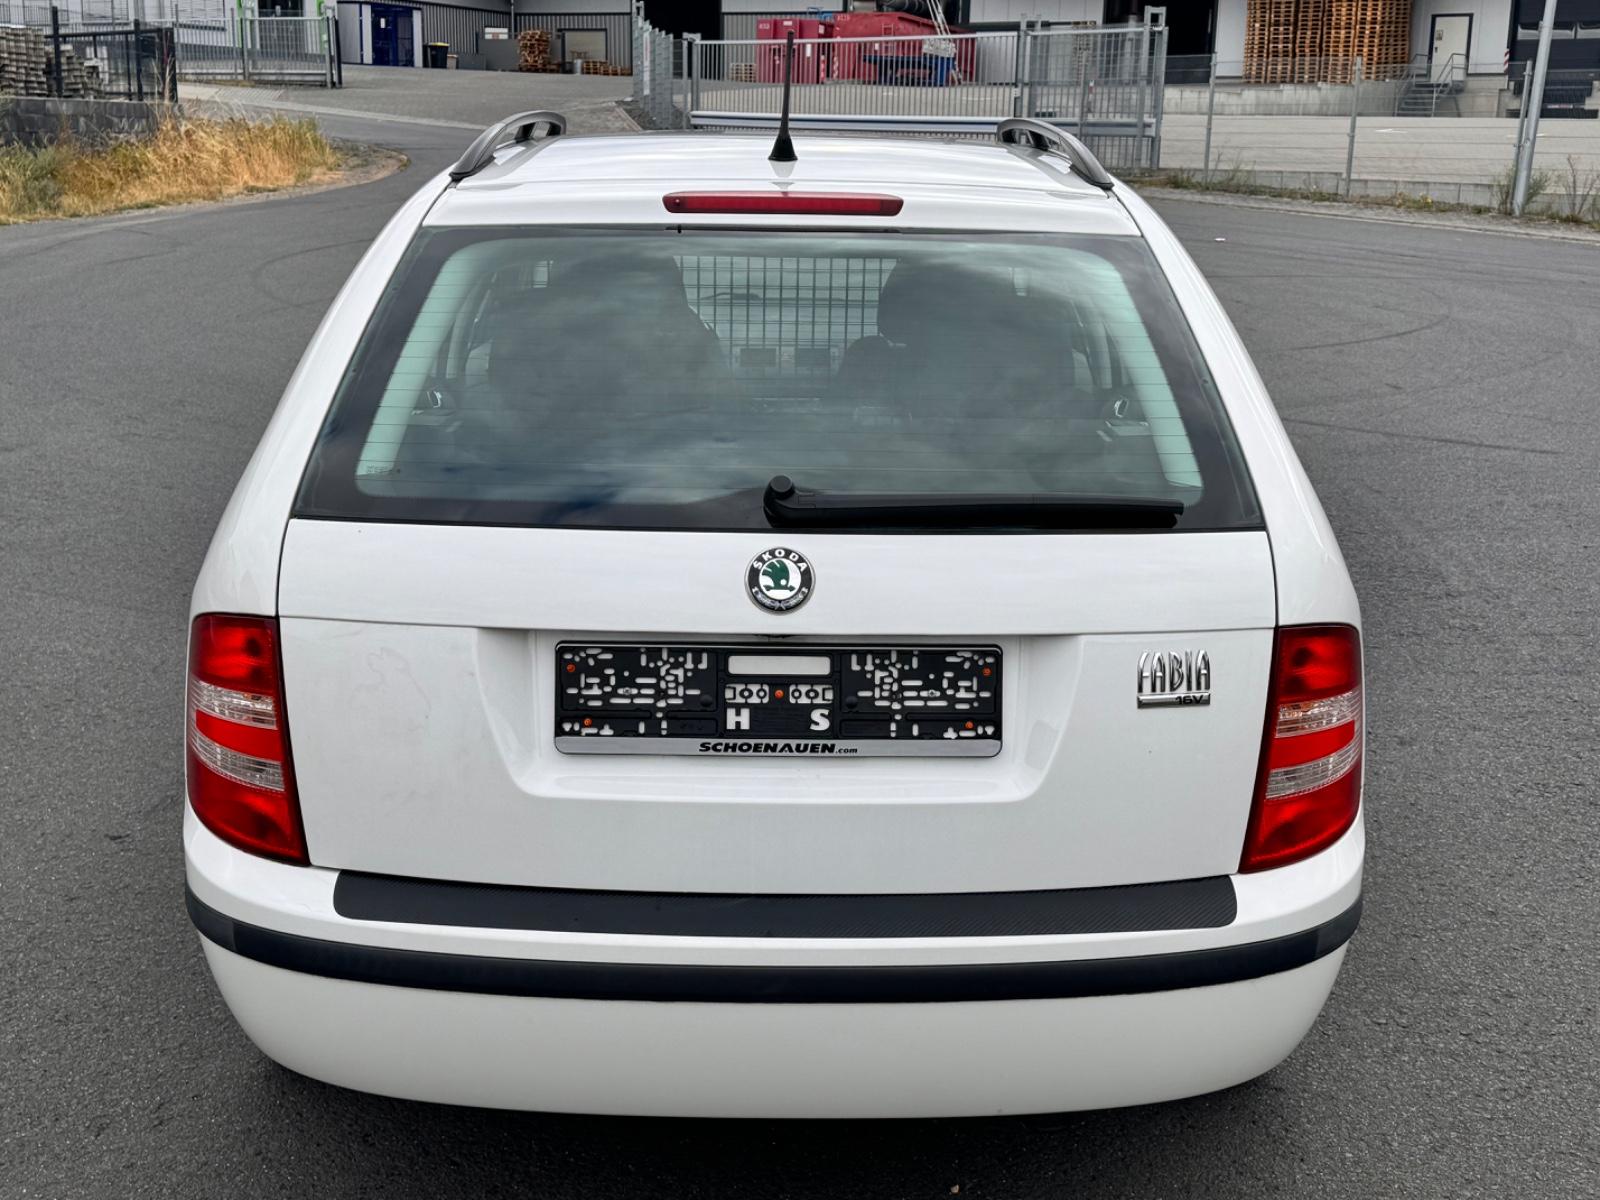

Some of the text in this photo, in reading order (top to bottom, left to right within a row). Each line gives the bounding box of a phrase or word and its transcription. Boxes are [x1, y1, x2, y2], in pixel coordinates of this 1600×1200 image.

[753, 549, 808, 572] SKODA
[1137, 650, 1210, 693] FABIA
[1175, 695, 1203, 704] 16V
[726, 708, 831, 731] H S
